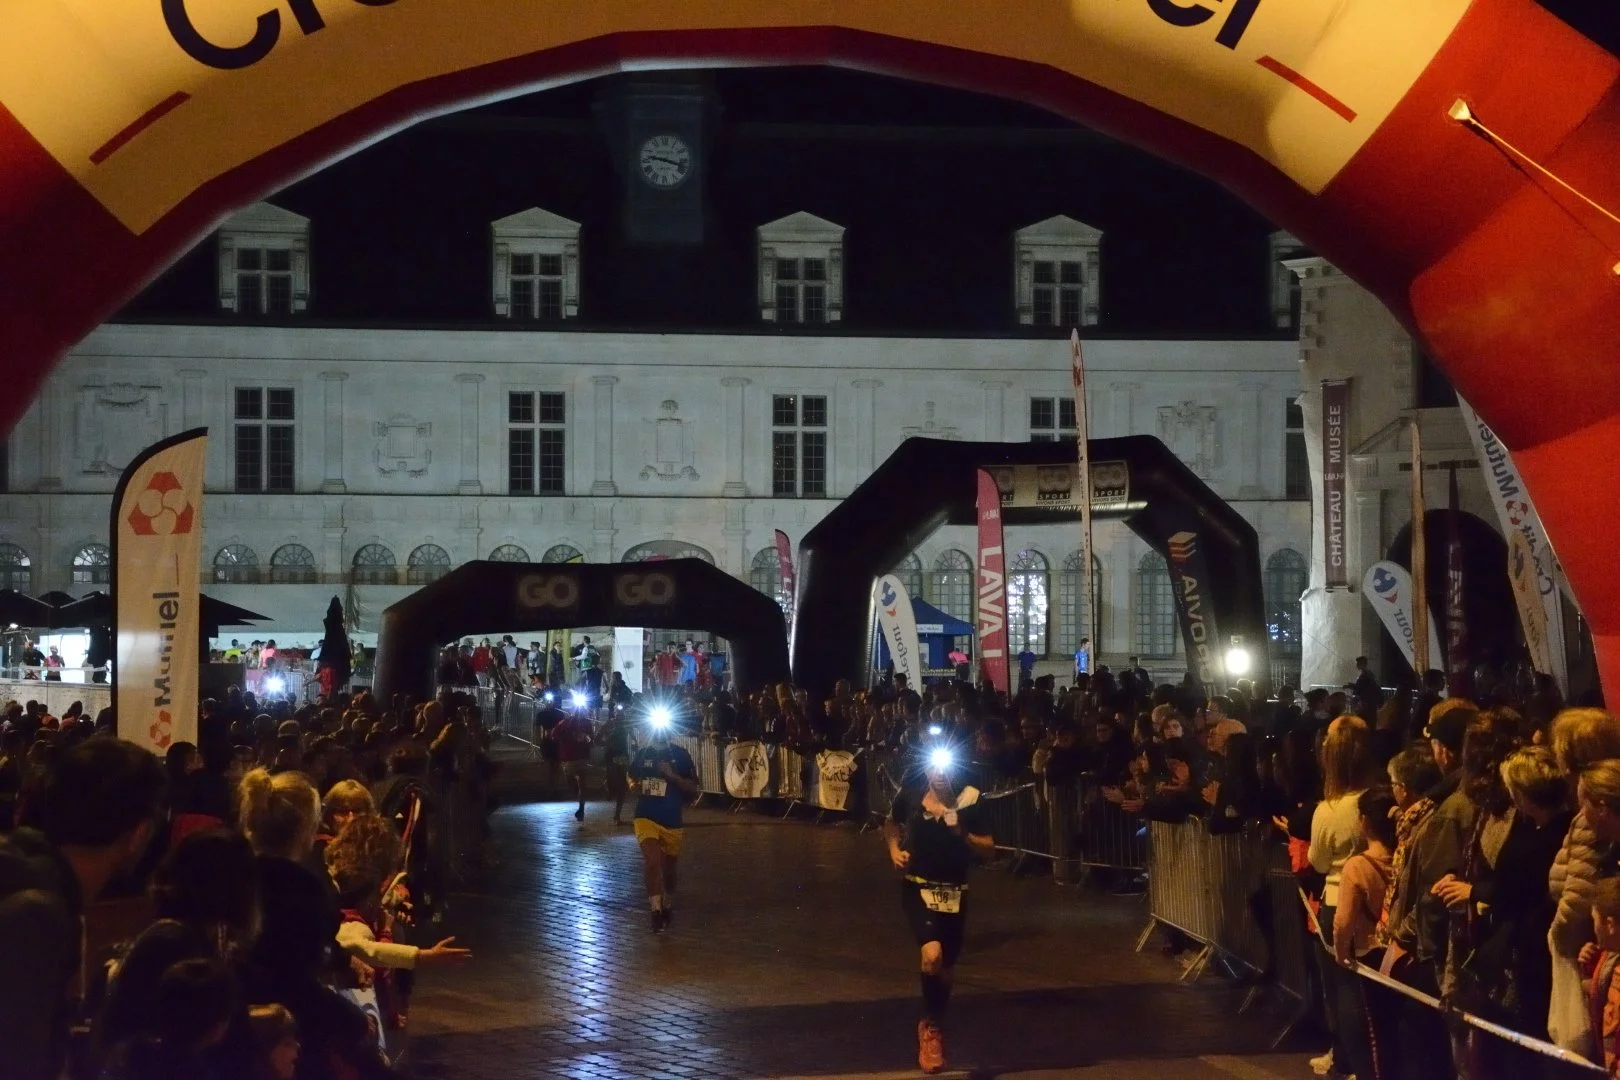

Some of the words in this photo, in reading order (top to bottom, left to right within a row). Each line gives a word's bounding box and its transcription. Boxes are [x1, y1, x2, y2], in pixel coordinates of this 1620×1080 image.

[1328, 405, 1340, 463] MUSÉE
[1329, 490, 1342, 567] CHÂTEAU
[518, 573, 579, 608] GO
[615, 572, 676, 606] GO
